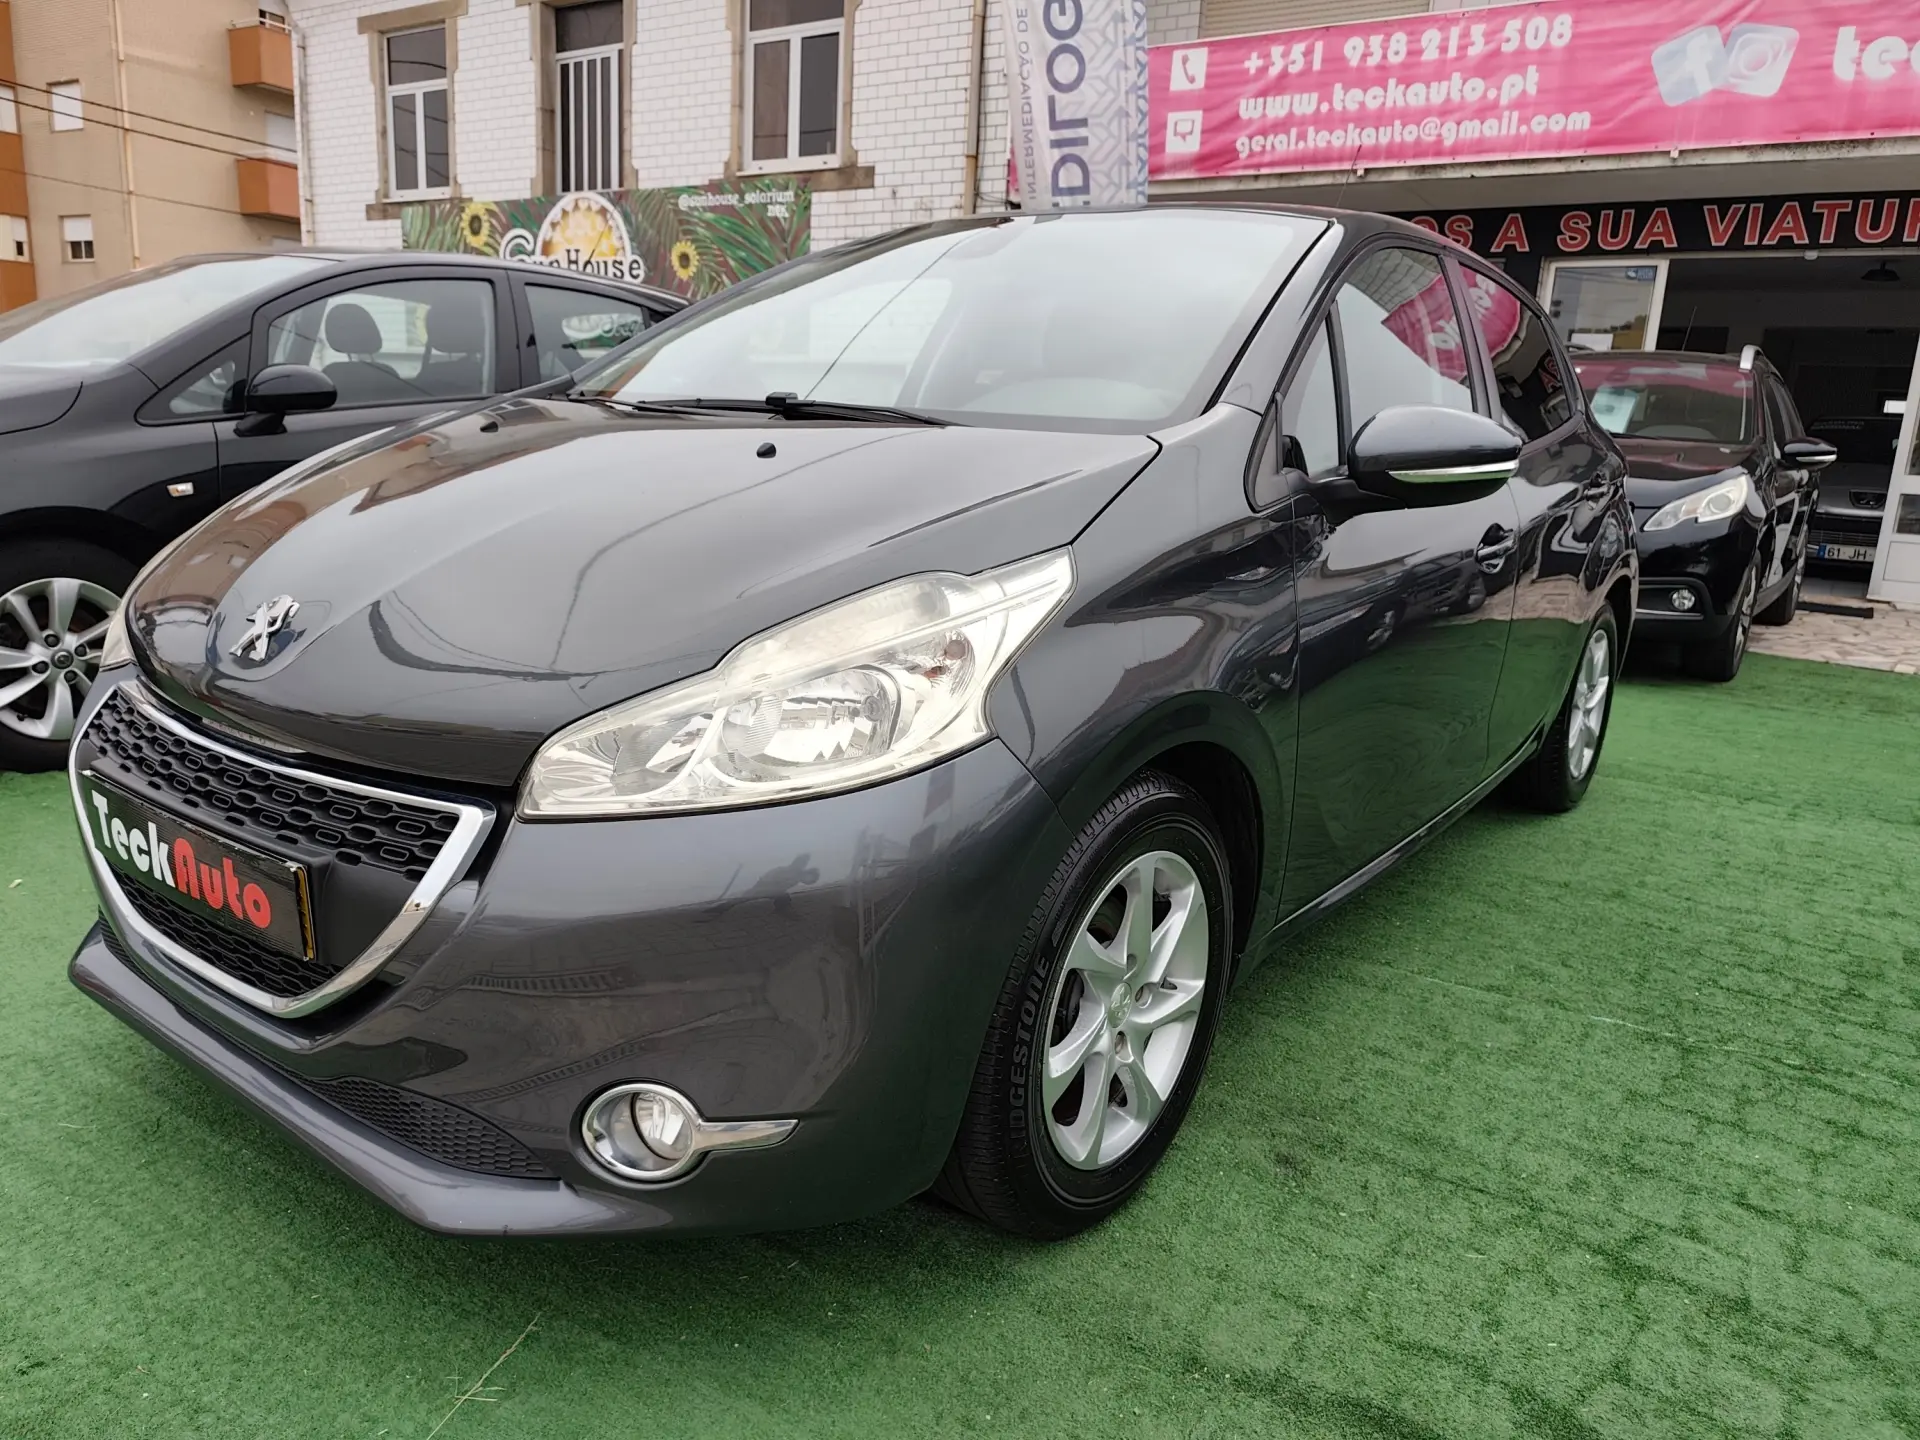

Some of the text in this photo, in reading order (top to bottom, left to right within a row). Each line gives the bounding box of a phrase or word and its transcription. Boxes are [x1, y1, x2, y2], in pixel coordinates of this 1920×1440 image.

[1243, 13, 1573, 76] +351 938 213 508
[1833, 26, 1920, 81] te
[1238, 64, 1540, 120] www.teckauto.pt
[1235, 110, 1592, 159] geral.teckauto@gmail.com
[502, 232, 644, 282] SnHouse
[1490, 212, 1530, 253] A
[1557, 207, 1678, 253] SUA
[91, 788, 272, 929] TeckAuto
